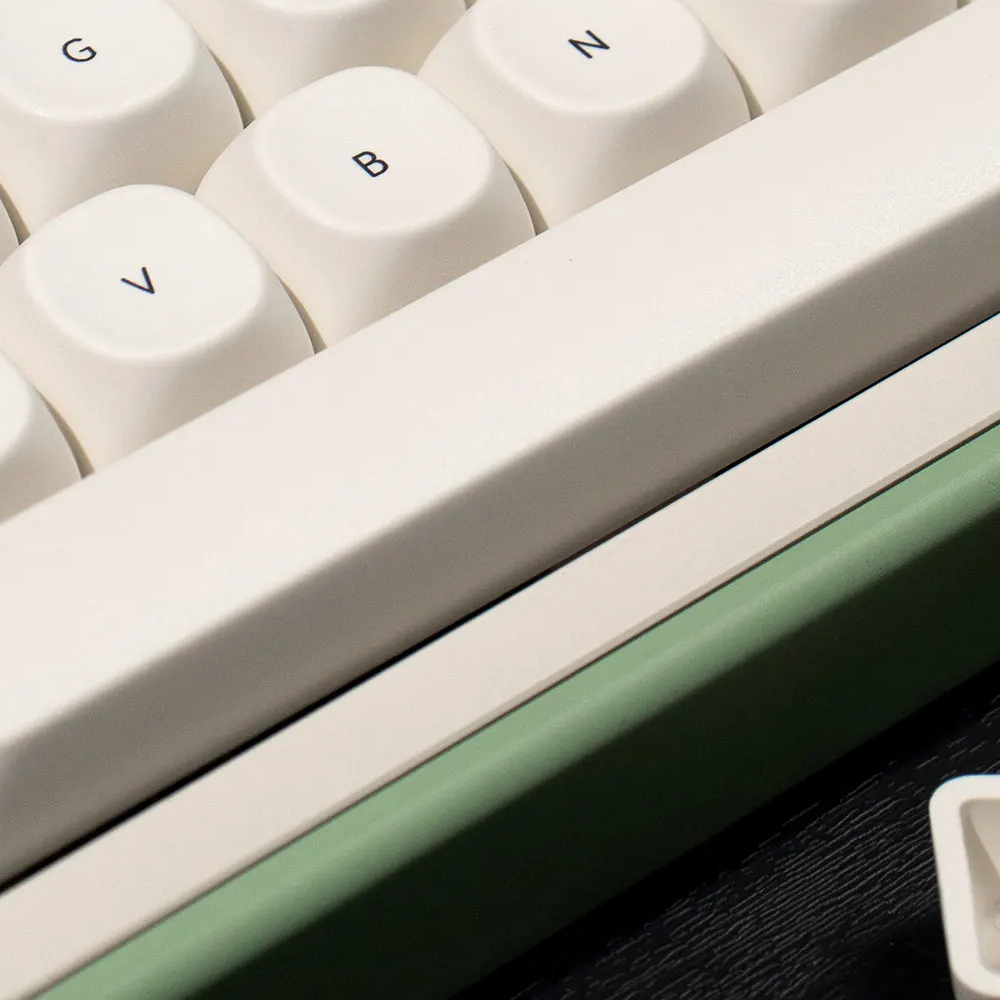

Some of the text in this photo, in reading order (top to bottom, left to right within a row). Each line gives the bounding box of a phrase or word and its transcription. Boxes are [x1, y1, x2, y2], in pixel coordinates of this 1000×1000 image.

[61, 37, 98, 63] G
[567, 29, 611, 60] N
[351, 150, 389, 178] B
[120, 266, 156, 295] V
